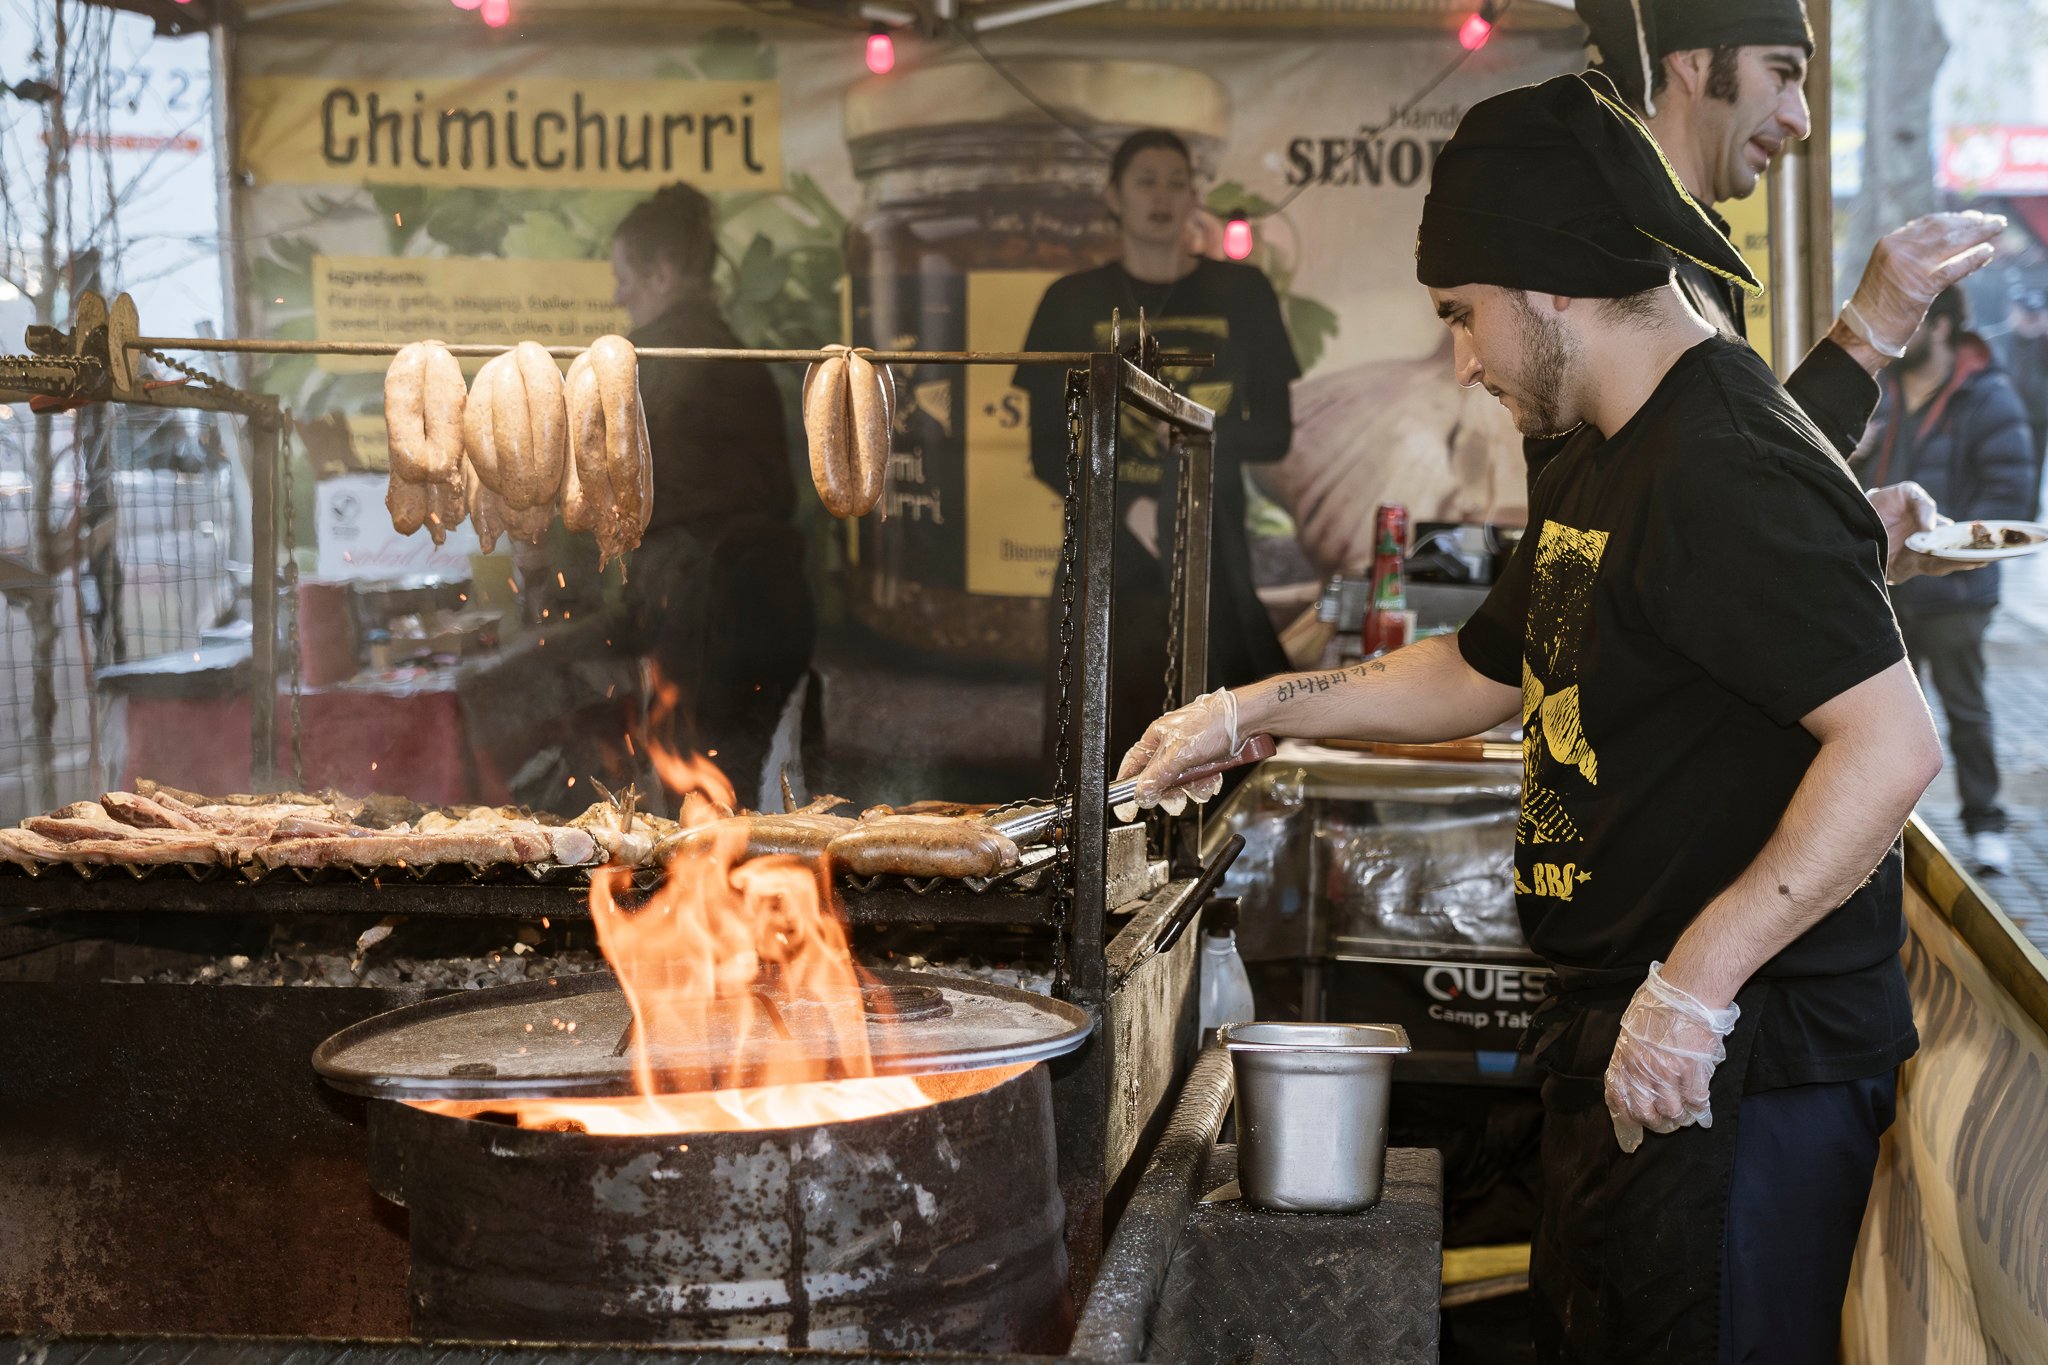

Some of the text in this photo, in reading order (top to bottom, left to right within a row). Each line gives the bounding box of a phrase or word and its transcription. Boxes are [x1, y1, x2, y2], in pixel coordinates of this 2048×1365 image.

[321, 87, 764, 173] Chimichurri
[1533, 862, 1576, 902] BBQ
[1428, 1004, 1490, 1029] Camp
